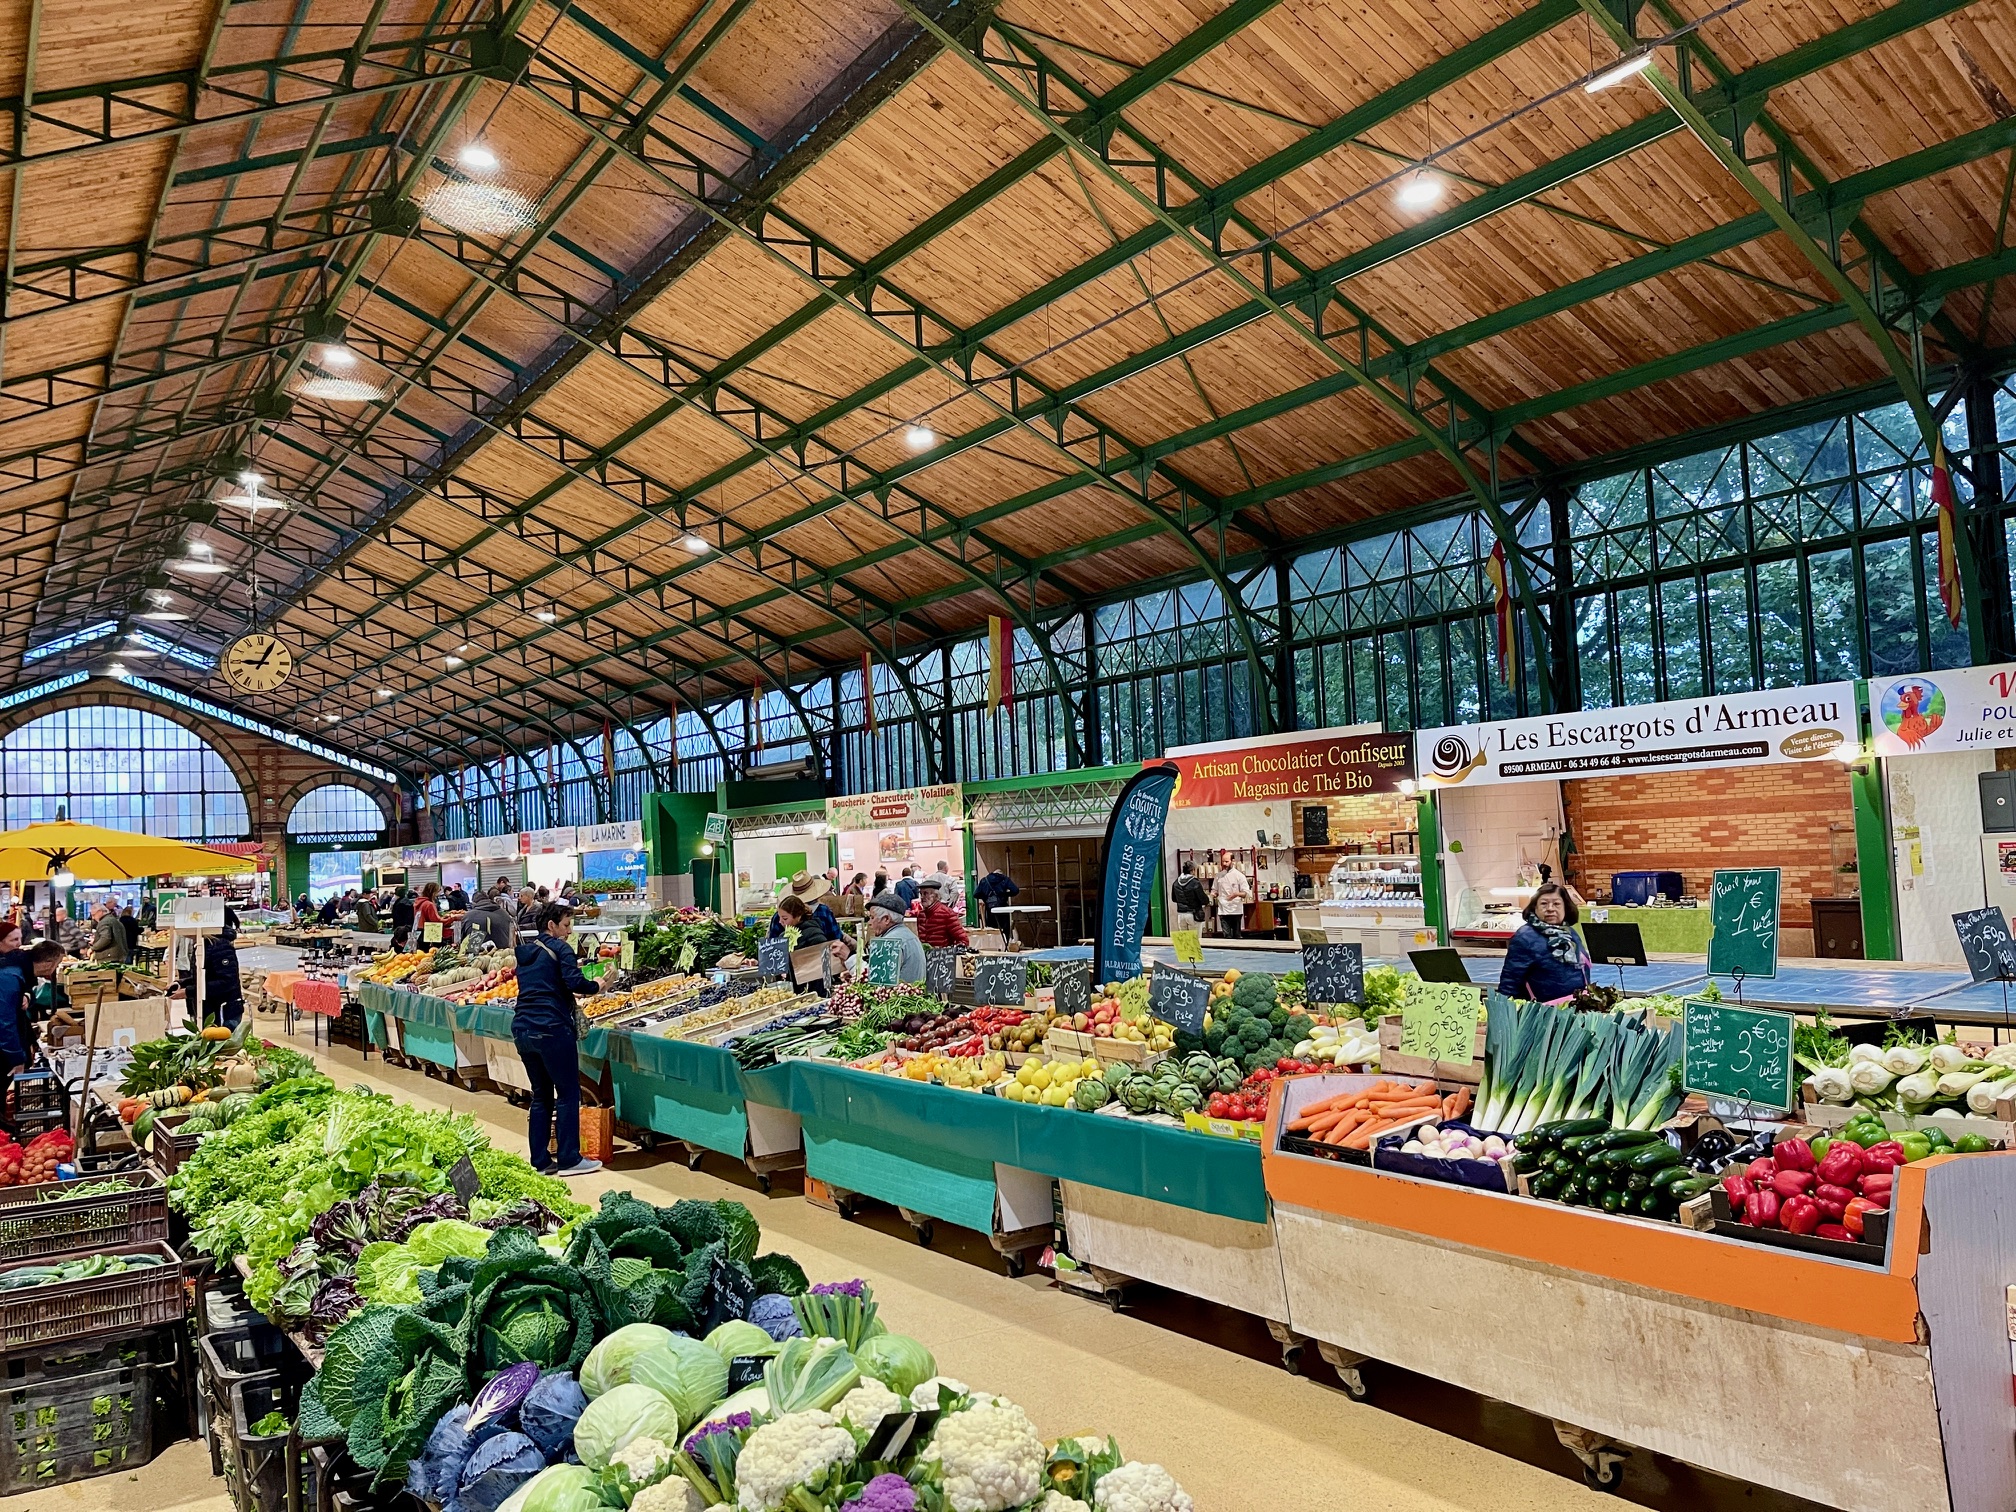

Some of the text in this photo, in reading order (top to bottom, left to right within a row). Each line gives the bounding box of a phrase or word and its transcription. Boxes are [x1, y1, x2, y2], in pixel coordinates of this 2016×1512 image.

[1989, 671, 2016, 698] V
[1498, 702, 1840, 752] Les Escargots d'Armeau
[1790, 732, 1833, 746] Vente directe
[1956, 727, 2013, 742] Julie et
[1193, 742, 1406, 780] Artisan Chocolatier Confiseur
[1503, 745, 1762, 774] 89500 ARMEAU 06 34 49 66 48 www.lesescargotsdarmeau.com
[1784, 747, 1802, 755] Visite
[832, 787, 954, 808] Boucherie Charcuterie Volailles
[1233, 770, 1372, 800] Magasin de Thé Bio
[1130, 795, 1162, 819] GOGUETTE
[592, 829, 599, 842] LA
[601, 825, 625, 841] MARINE
[707, 822, 721, 833] AB
[1114, 844, 1134, 947] PRODUCTEURS
[1127, 855, 1145, 943] MARAICHERS
[1973, 925, 2006, 972] 3€90
[1157, 985, 1193, 1014] 2€90
[1435, 987, 1473, 1013] 2€50
[1425, 1015, 1463, 1048] 2€90
[1730, 1019, 1788, 1072] 3€90
